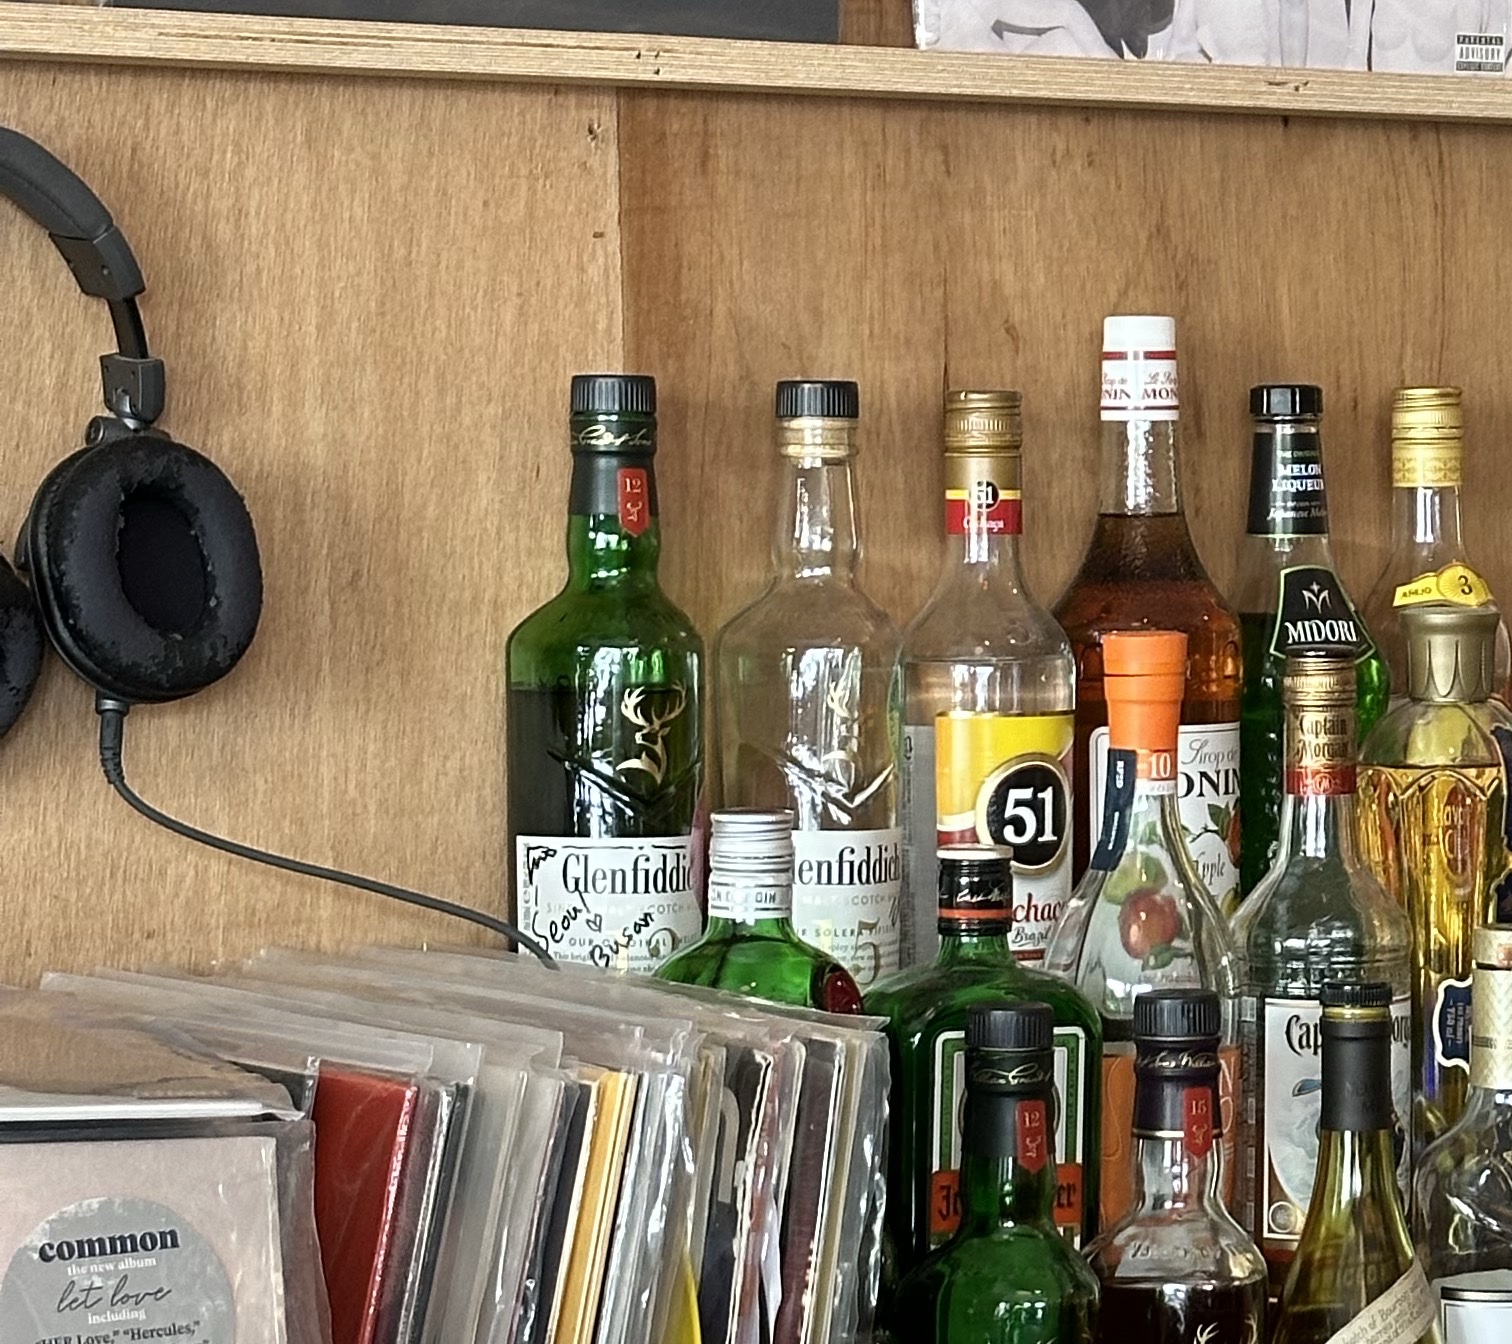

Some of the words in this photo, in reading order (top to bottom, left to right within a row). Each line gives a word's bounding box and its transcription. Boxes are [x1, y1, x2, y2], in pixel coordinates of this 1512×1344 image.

[625, 477, 641, 493] 12
[1457, 575, 1474, 596] 3
[1285, 620, 1357, 644] MIDORI
[1299, 714, 1348, 736] Captain
[1181, 738, 1226, 766] Sirop
[1150, 753, 1172, 778] 10
[1002, 787, 1060, 844] 51
[1191, 1100, 1207, 1115] 15
[1023, 1111, 1041, 1128] 12
[39, 1228, 179, 1263] common
[67, 1265, 89, 1276] the
[90, 1262, 115, 1273] new
[118, 1258, 157, 1270] album
[58, 1279, 103, 1313] let
[111, 1273, 172, 1307] love
[88, 1309, 147, 1324] including
